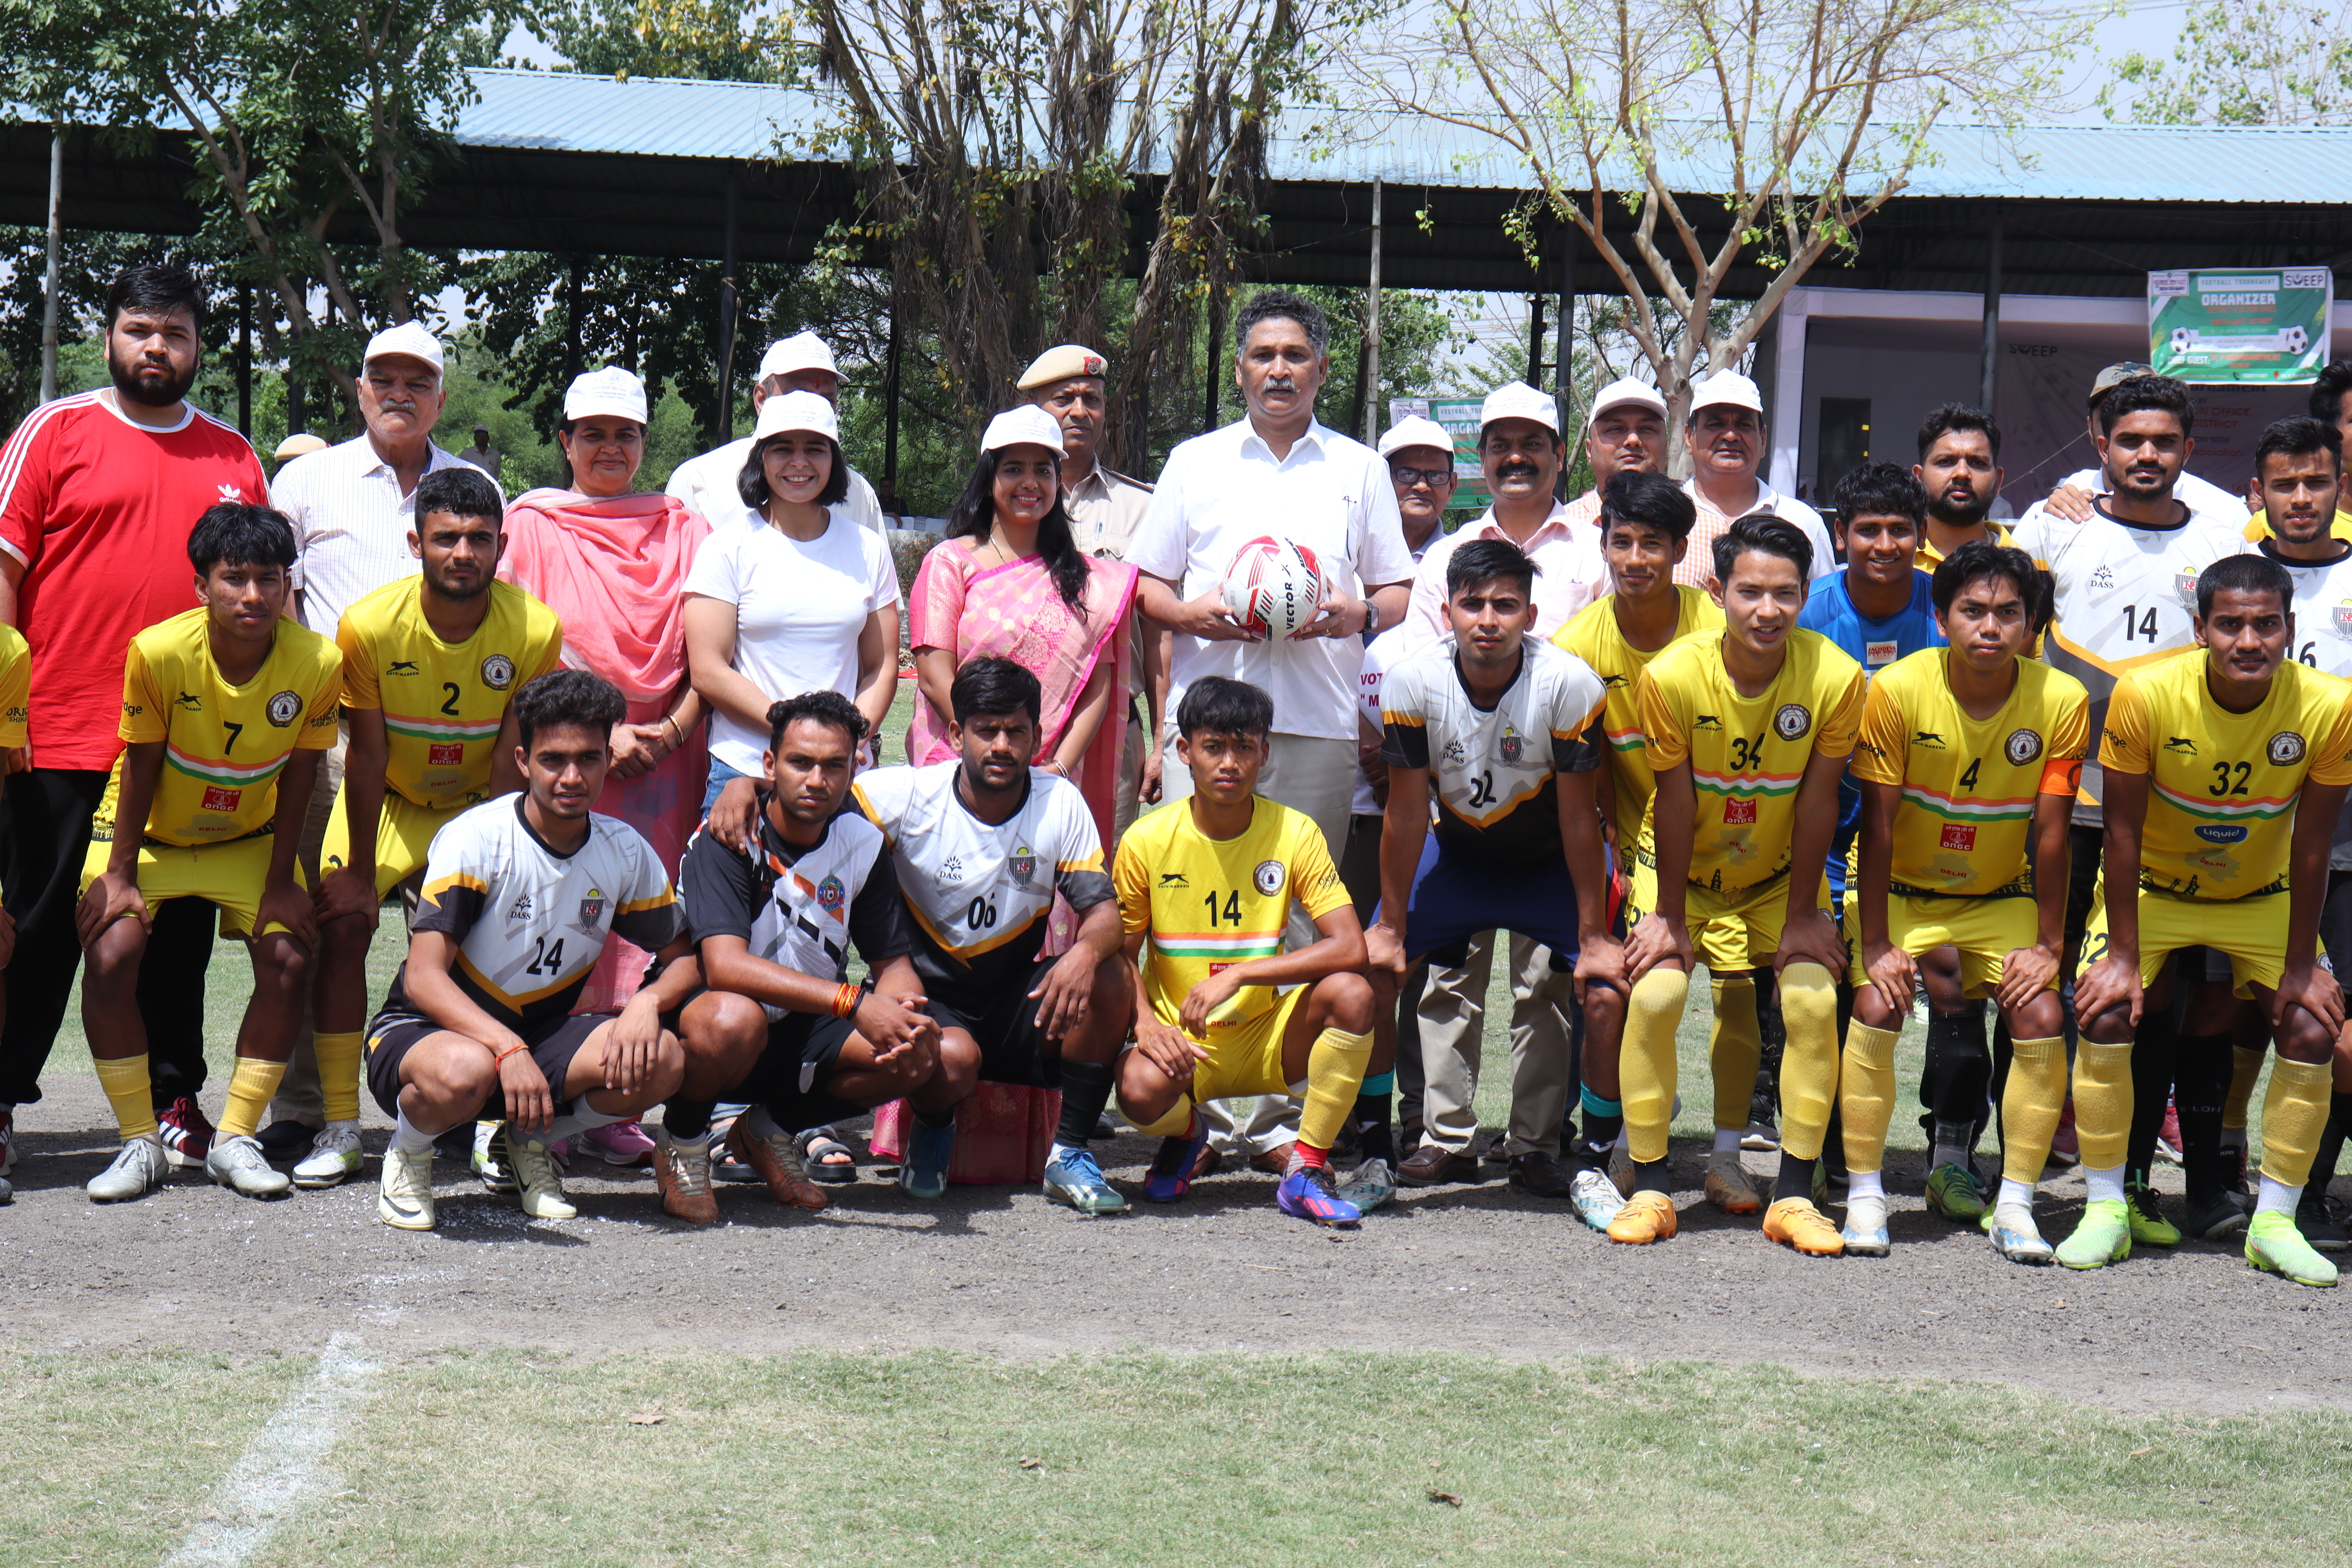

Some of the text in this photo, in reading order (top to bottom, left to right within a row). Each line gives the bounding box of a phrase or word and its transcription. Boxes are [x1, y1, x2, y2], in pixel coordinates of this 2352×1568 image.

[2201, 293, 2276, 306] ORGANIZER
[2009, 343, 2058, 357] SWEEP
[2167, 356, 2186, 365] CHIEF
[2187, 356, 2210, 364] GUEST:
[2211, 407, 2254, 417] OFFICE,
[1443, 422, 1482, 435] ORGAN
[2191, 448, 2244, 457] ssociation
[219, 496, 242, 505] adidas
[2090, 580, 2114, 588] DASS
[1285, 582, 1295, 630] VECTOR
[2123, 604, 2158, 643] 14
[1360, 672, 1384, 686] VOT
[440, 682, 460, 716] 2
[1368, 694, 1379, 707] M
[6, 707, 29, 717] ORIG
[223, 720, 243, 756] 7
[2103, 727, 2127, 748] edge
[1730, 732, 1766, 771] 34
[1911, 740, 1946, 750] SHIV-NARESH
[2163, 745, 2198, 756] SHIV-NARESH
[1442, 753, 1465, 764] DASS
[1959, 757, 1982, 792] 4
[2209, 760, 2252, 797] 32
[1469, 770, 1497, 809] 22
[2203, 828, 2239, 838] Liquid
[939, 871, 963, 881] DASS
[1940, 868, 1967, 879] DELHI
[967, 892, 997, 931] 06
[1205, 889, 1242, 927] 14
[510, 911, 532, 920] DASS
[526, 936, 564, 976] 24
